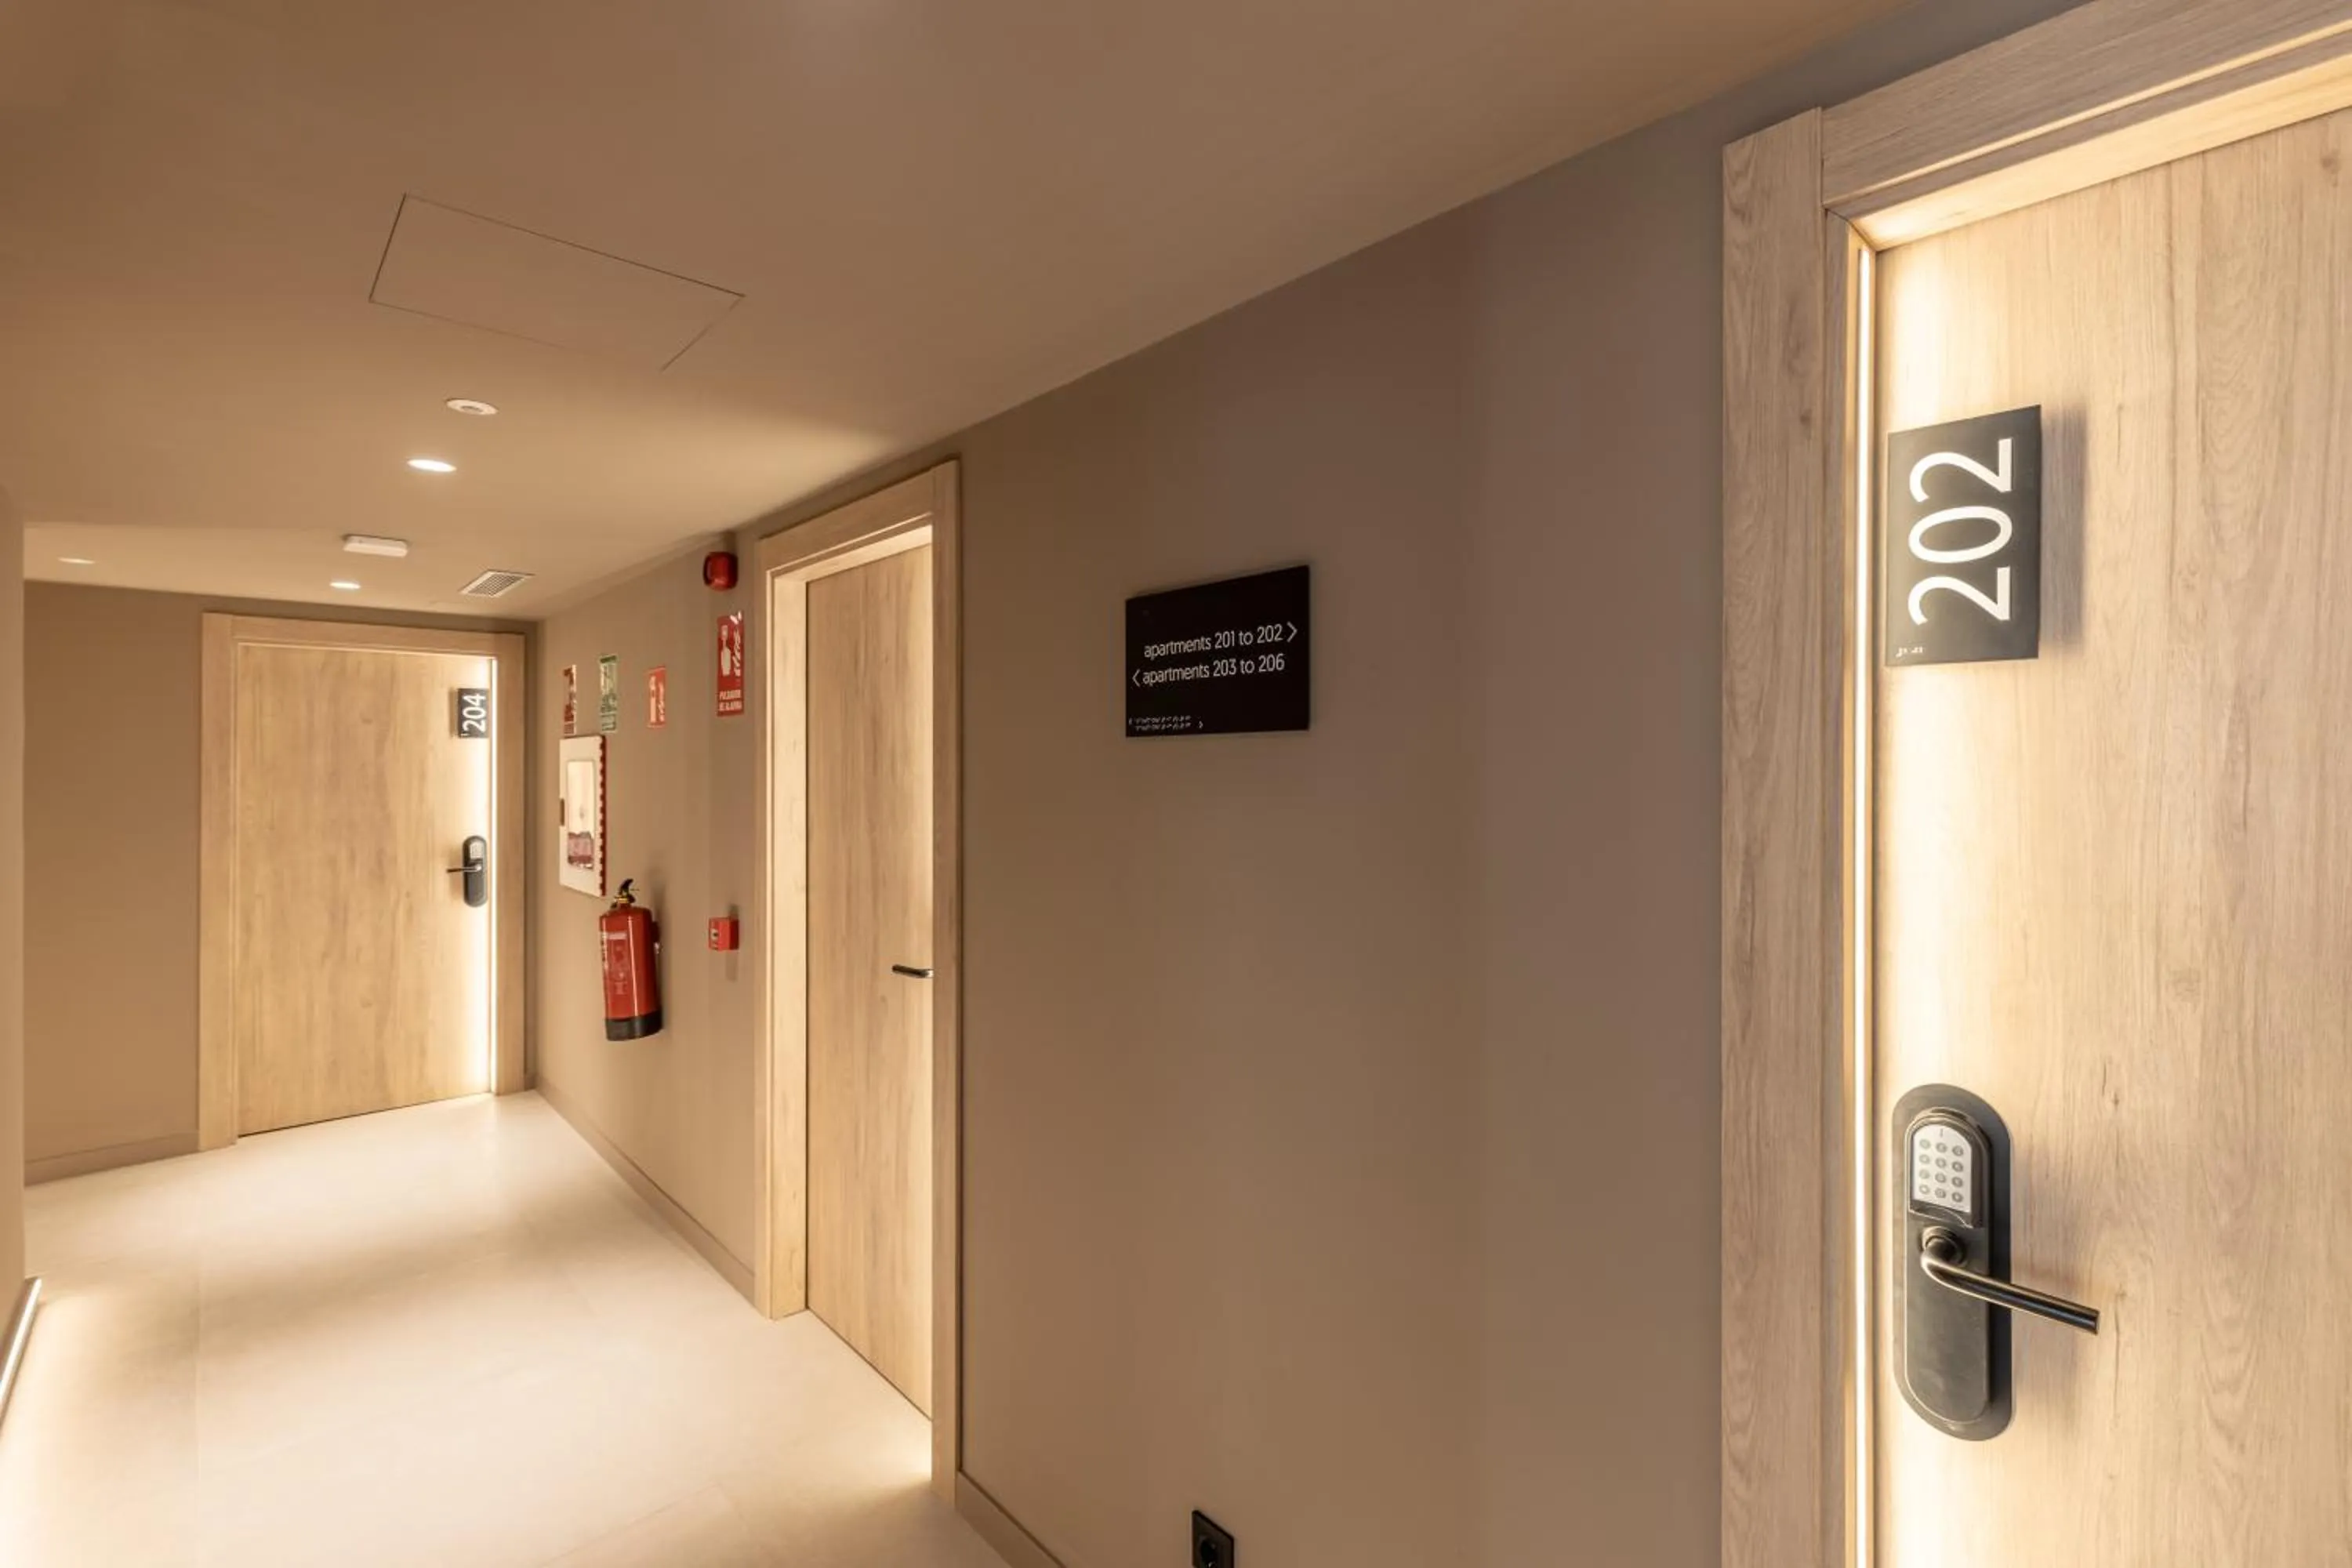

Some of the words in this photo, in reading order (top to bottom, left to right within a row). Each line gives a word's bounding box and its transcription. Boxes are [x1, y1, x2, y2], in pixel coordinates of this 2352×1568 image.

[1907, 437, 2013, 626] 202
[1144, 637, 1211, 660] apartments
[1214, 630, 1235, 649] 201
[1239, 630, 1254, 645] to
[1257, 623, 1283, 644] 202
[1142, 664, 1210, 686] apartments
[1213, 658, 1236, 677] 203
[1240, 659, 1255, 674] to
[1258, 653, 1285, 672] 206
[462, 694, 486, 732] 204
